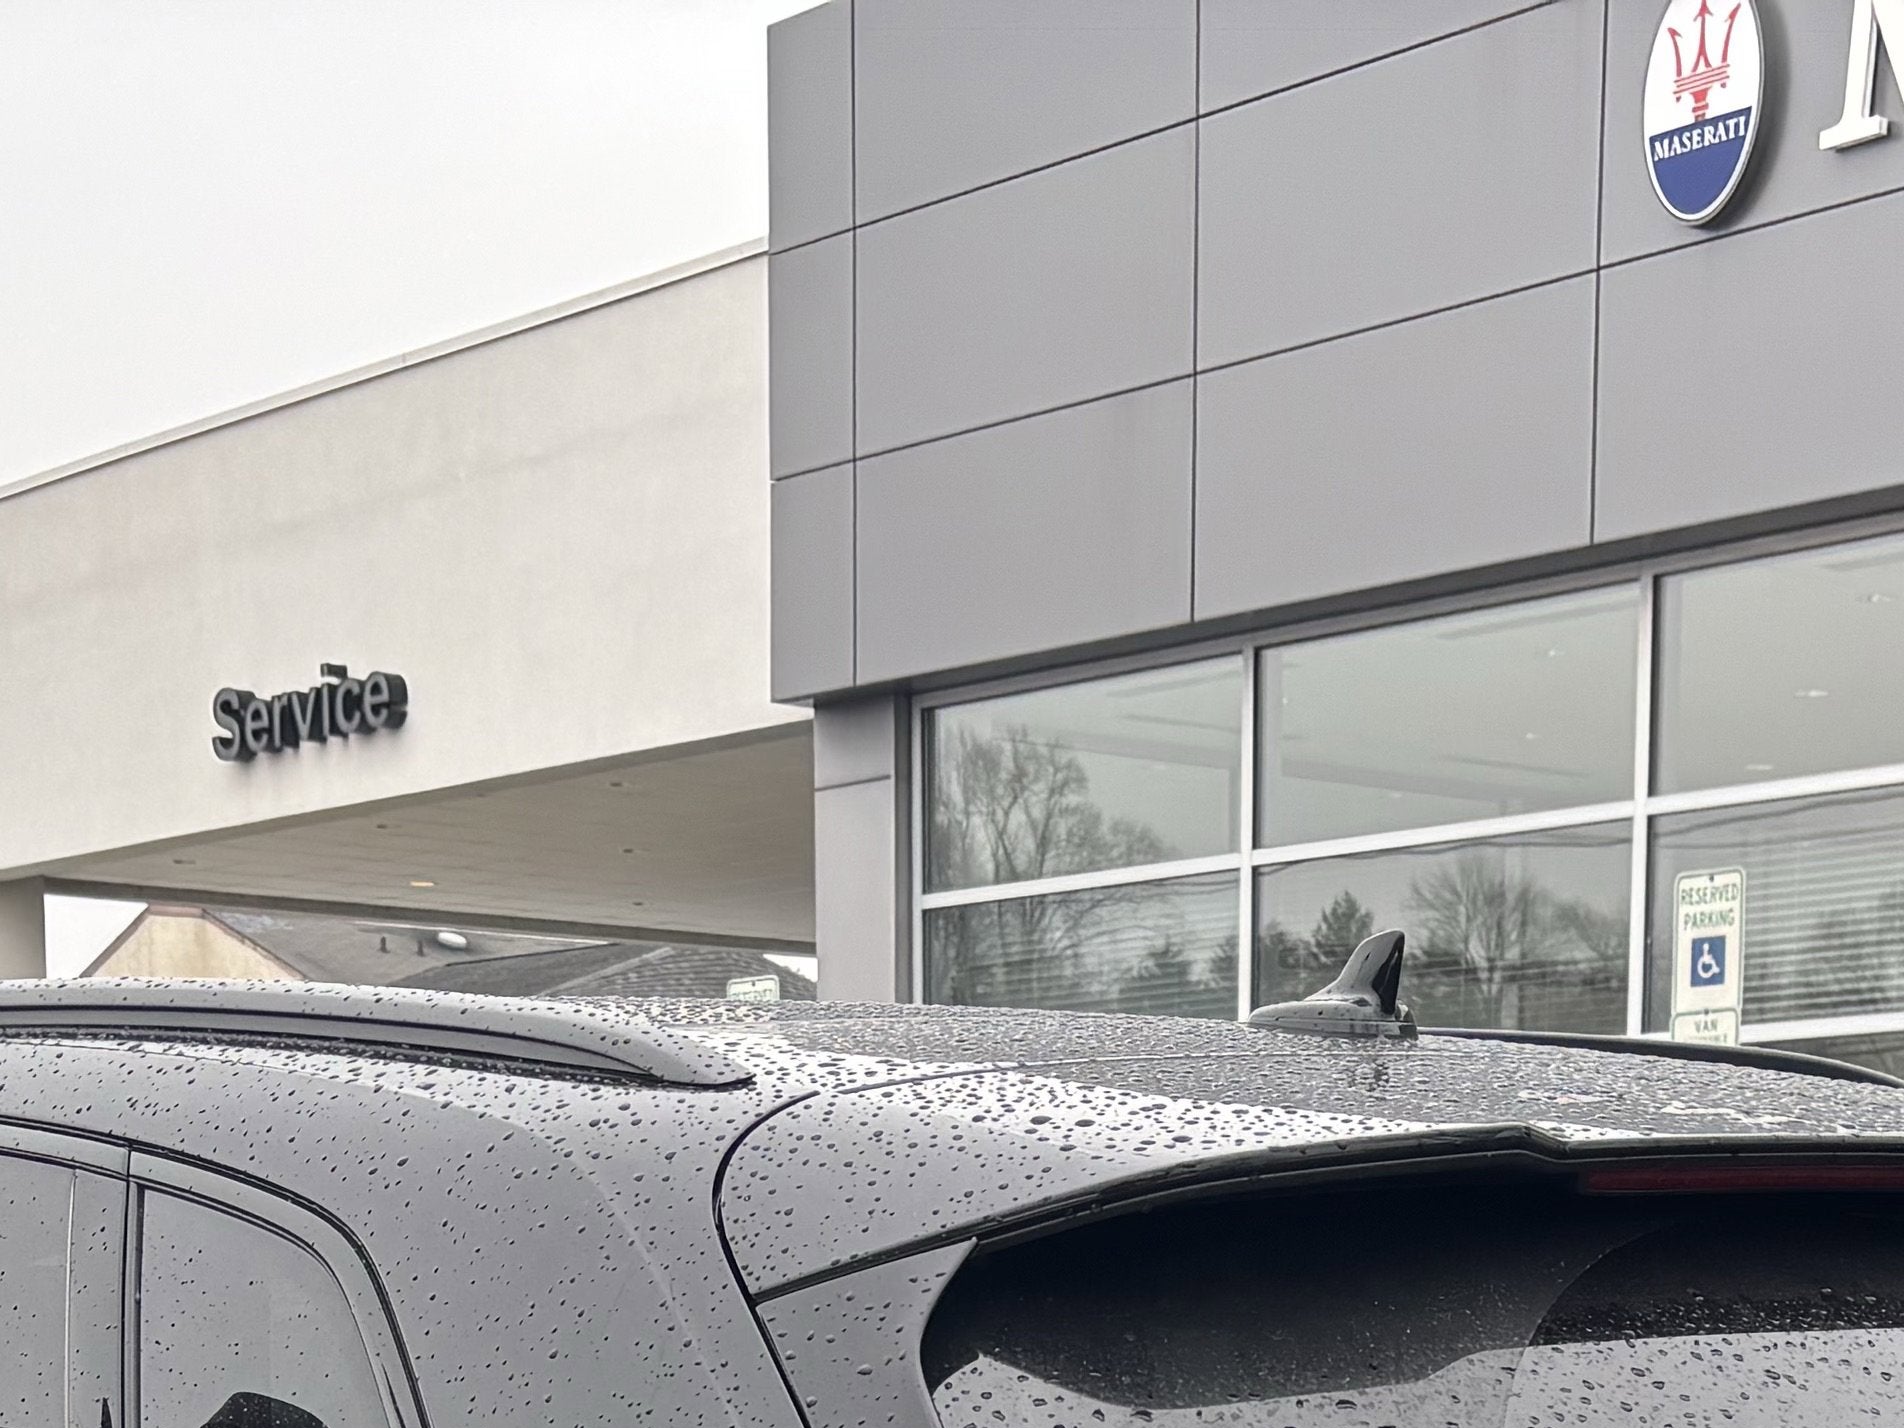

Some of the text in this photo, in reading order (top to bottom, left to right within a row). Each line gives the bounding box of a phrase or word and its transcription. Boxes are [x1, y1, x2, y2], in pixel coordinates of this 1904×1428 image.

[1654, 115, 1746, 162] MASERATI
[211, 662, 408, 762] Service
[1680, 882, 1740, 905] RESERVED
[1683, 908, 1735, 931] PARKING
[1694, 1018, 1718, 1034] VAN
